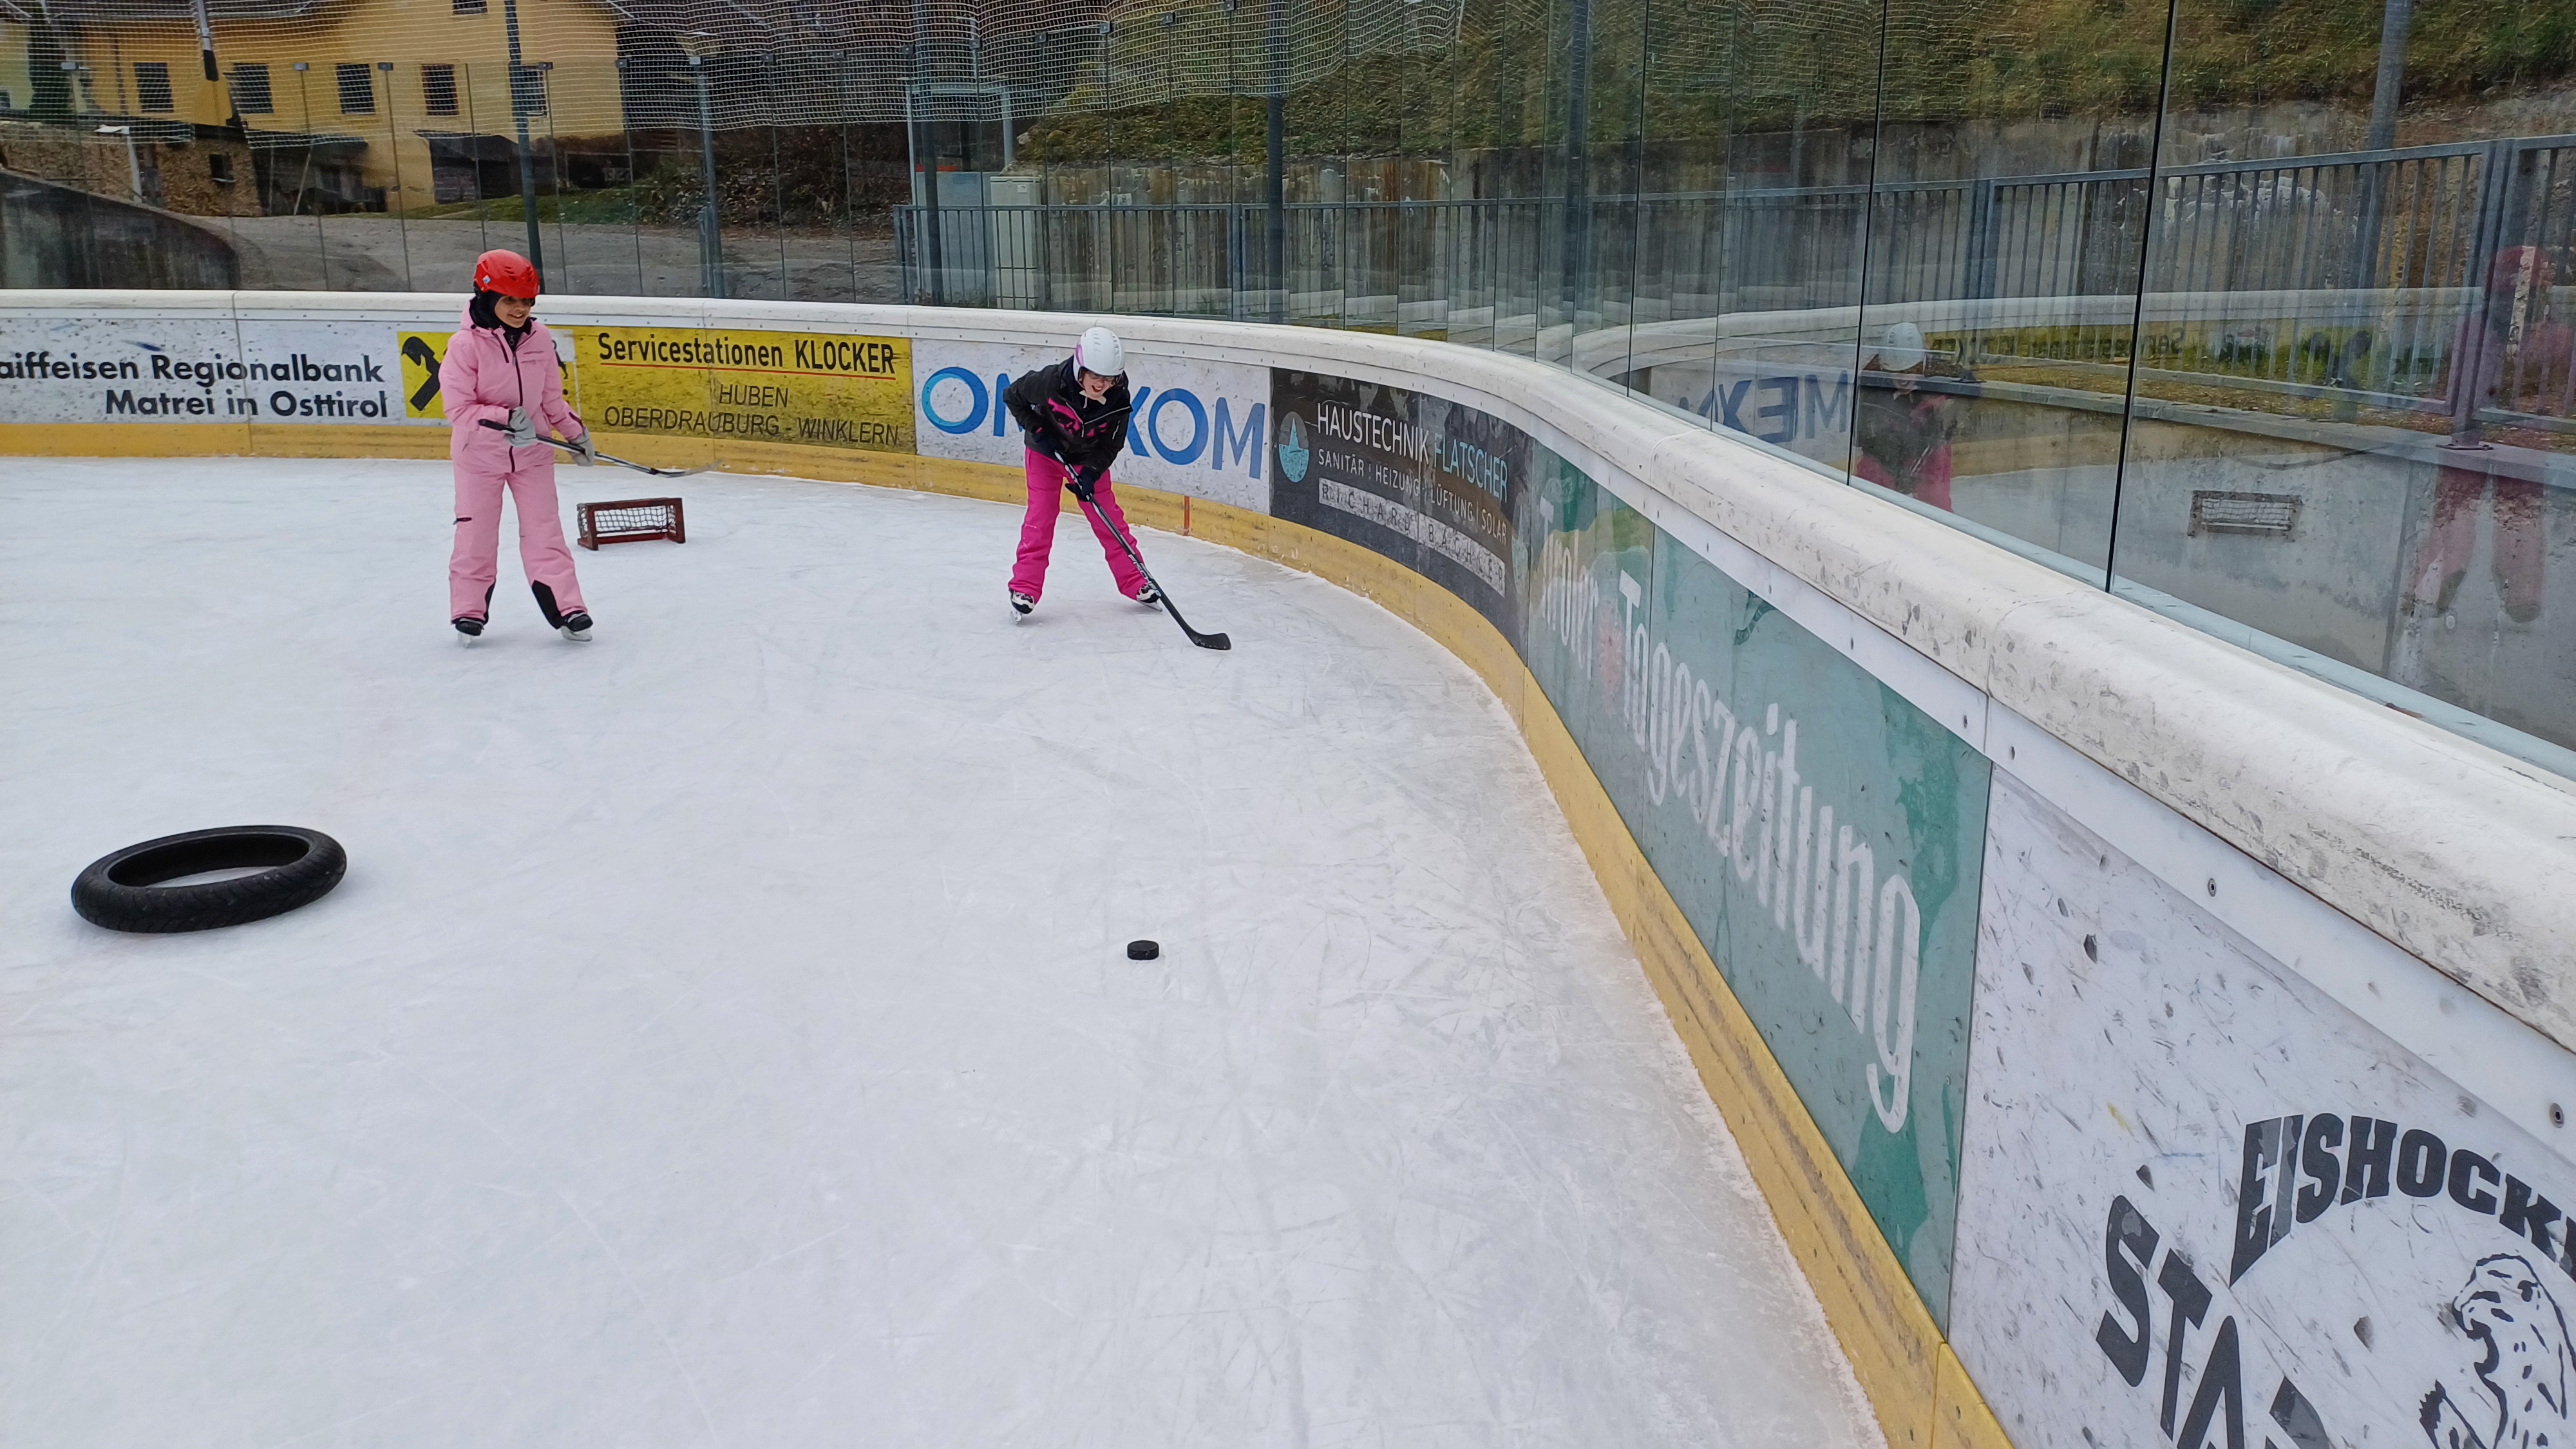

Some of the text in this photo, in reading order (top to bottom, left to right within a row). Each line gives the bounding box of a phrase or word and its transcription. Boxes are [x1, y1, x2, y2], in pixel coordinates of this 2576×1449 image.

[0, 350, 384, 386] aiffeisen Regionalbank
[598, 332, 895, 374] Servicestationen KLOCKER
[106, 388, 388, 418] Matrei in Osttirol
[719, 384, 789, 408] HUBEN
[604, 406, 779, 437] OBERDRAUBURG
[797, 418, 899, 446] WINKLERN
[1318, 402, 1508, 504] HAUSTECHNIK FLATSCHER
[1318, 448, 1506, 545] SANITÄR HEIZUNG LÜFTUNG SOLAR
[1322, 484, 1410, 531] RICHARD
[1619, 569, 1920, 1133] Tageszeitung
[2230, 1112, 2576, 1289] EISHOCK
